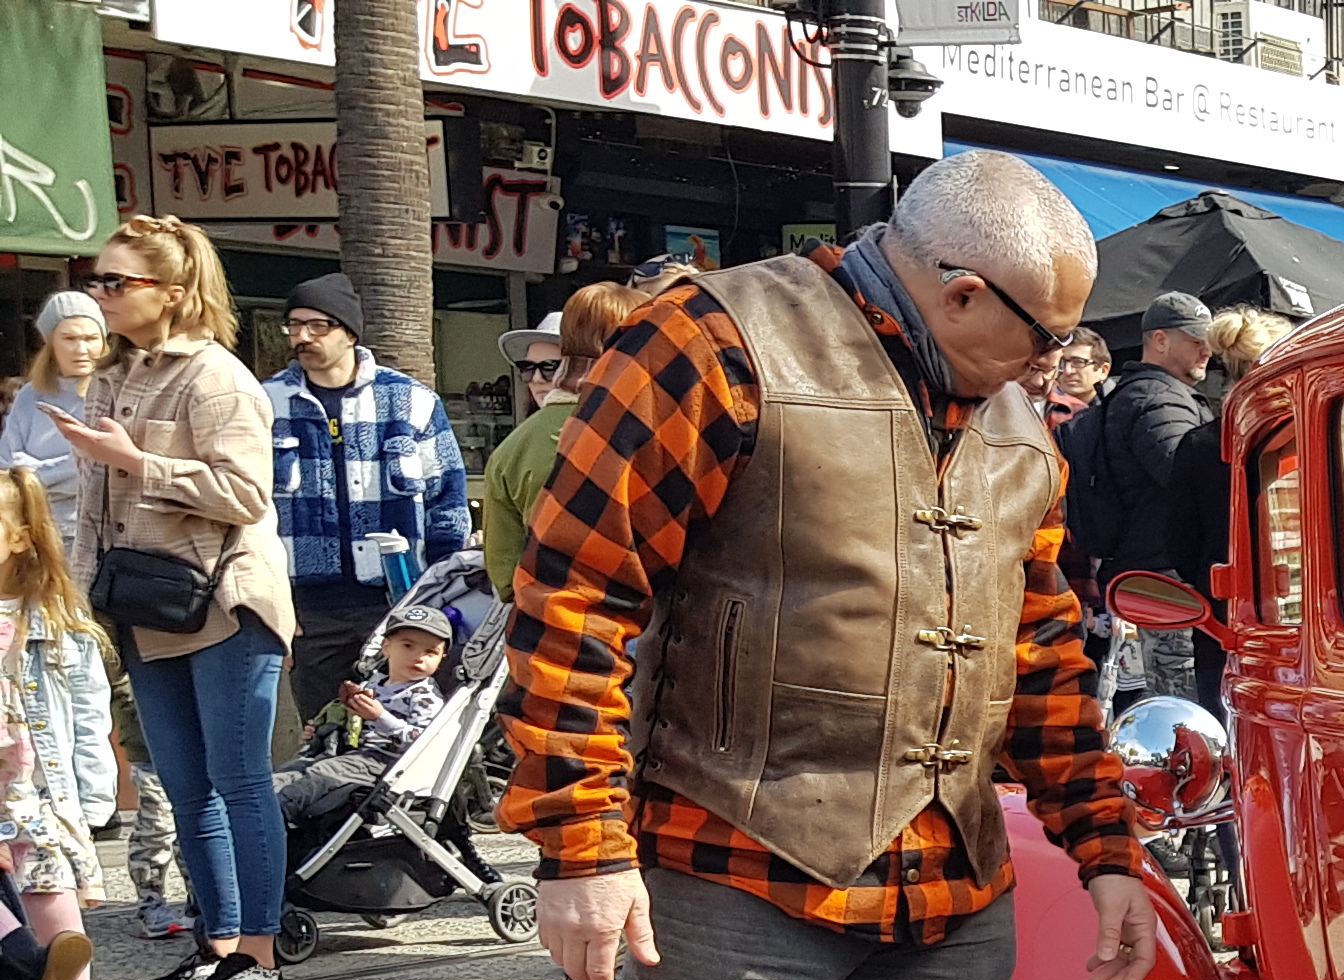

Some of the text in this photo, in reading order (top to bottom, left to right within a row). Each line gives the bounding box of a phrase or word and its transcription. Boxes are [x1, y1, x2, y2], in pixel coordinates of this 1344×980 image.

[942, 45, 1334, 143] Mediterranean Bar @ Restaurant
[159, 150, 246, 199] TVE
